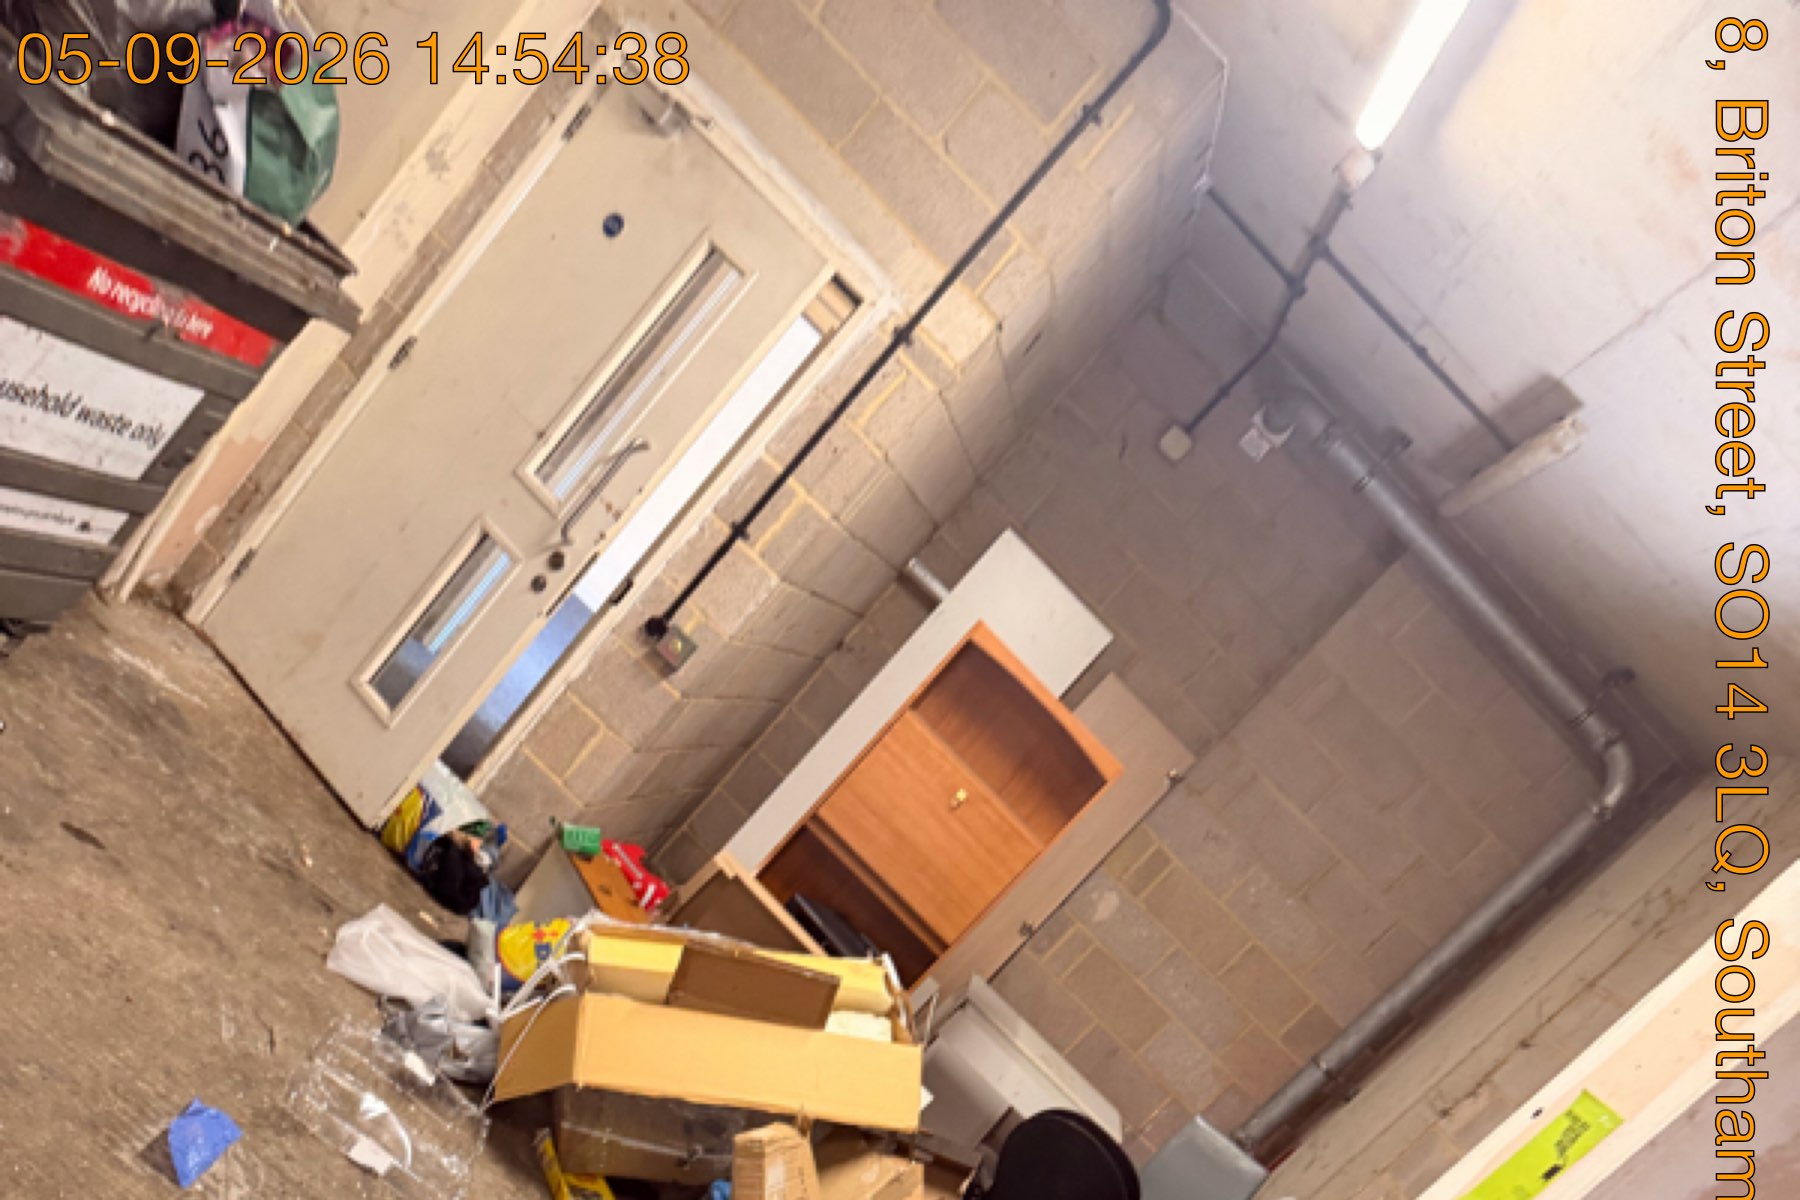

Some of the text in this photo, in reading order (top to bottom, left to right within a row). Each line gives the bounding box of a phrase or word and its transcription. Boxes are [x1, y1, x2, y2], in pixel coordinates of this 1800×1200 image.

[0, 379, 165, 450] usehold waste only
